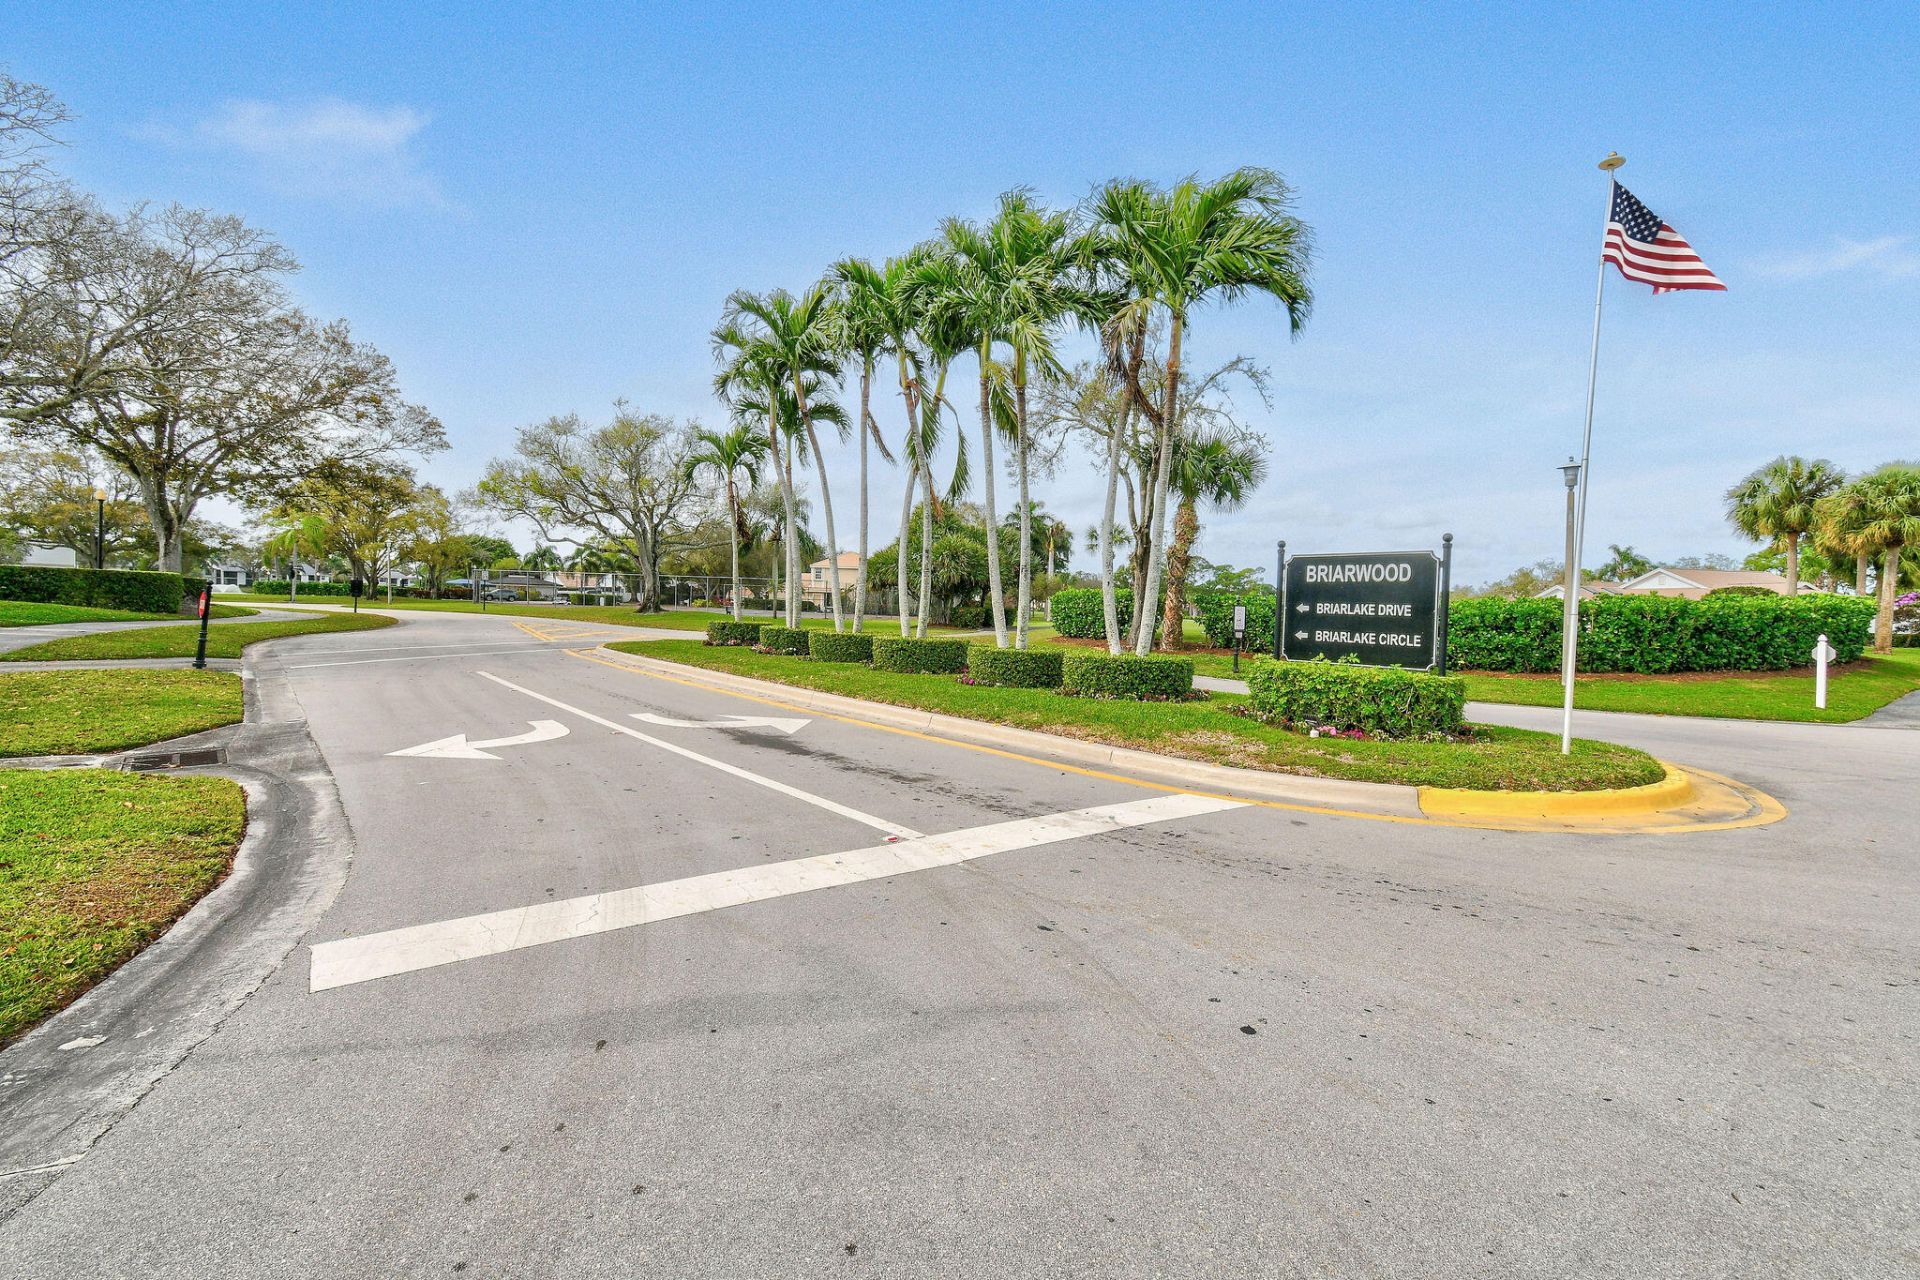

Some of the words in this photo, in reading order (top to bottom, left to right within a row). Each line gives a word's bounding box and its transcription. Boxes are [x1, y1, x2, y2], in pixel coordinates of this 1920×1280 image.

[1306, 563, 1412, 583] BRIARWOOD
[1316, 603, 1376, 616] BRIARLAKE
[1378, 604, 1412, 617] DRIVE
[1315, 630, 1376, 645] BRIARLAKE
[1378, 633, 1422, 647] CIRCLE
